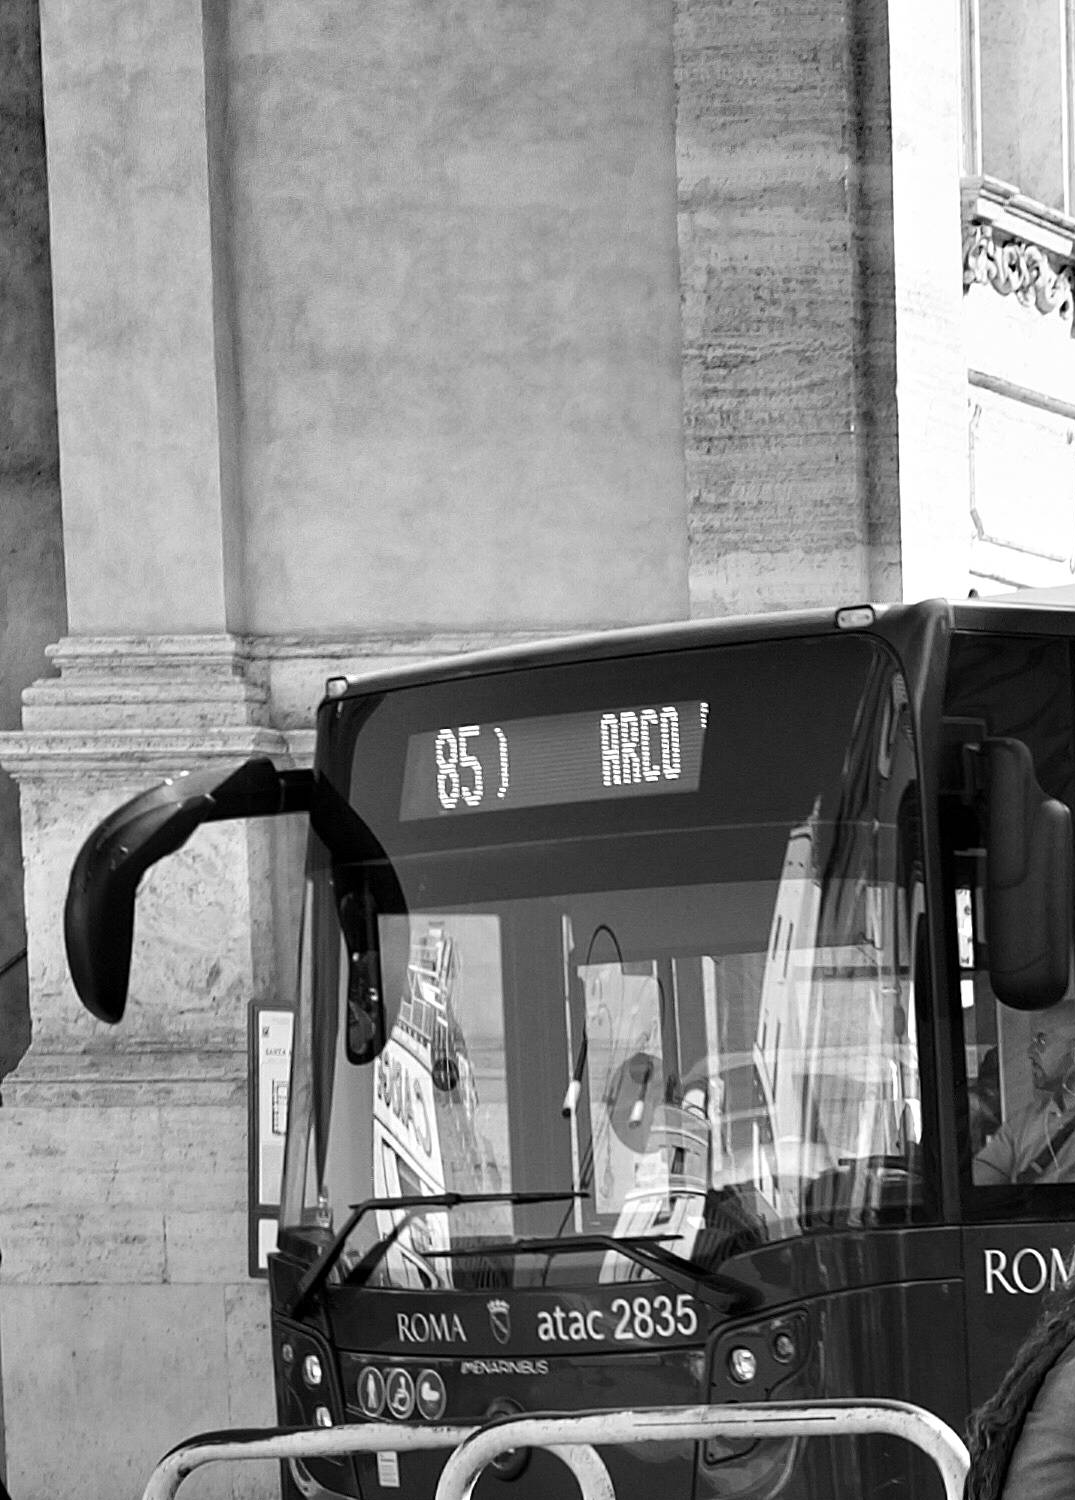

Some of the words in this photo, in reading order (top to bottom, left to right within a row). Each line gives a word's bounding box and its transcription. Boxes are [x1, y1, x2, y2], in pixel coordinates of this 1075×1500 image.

[600, 706, 681, 787] ARCO
[396, 1312, 468, 1344] ROMA
[537, 1305, 606, 1341] atac
[610, 1294, 698, 1340] 2835
